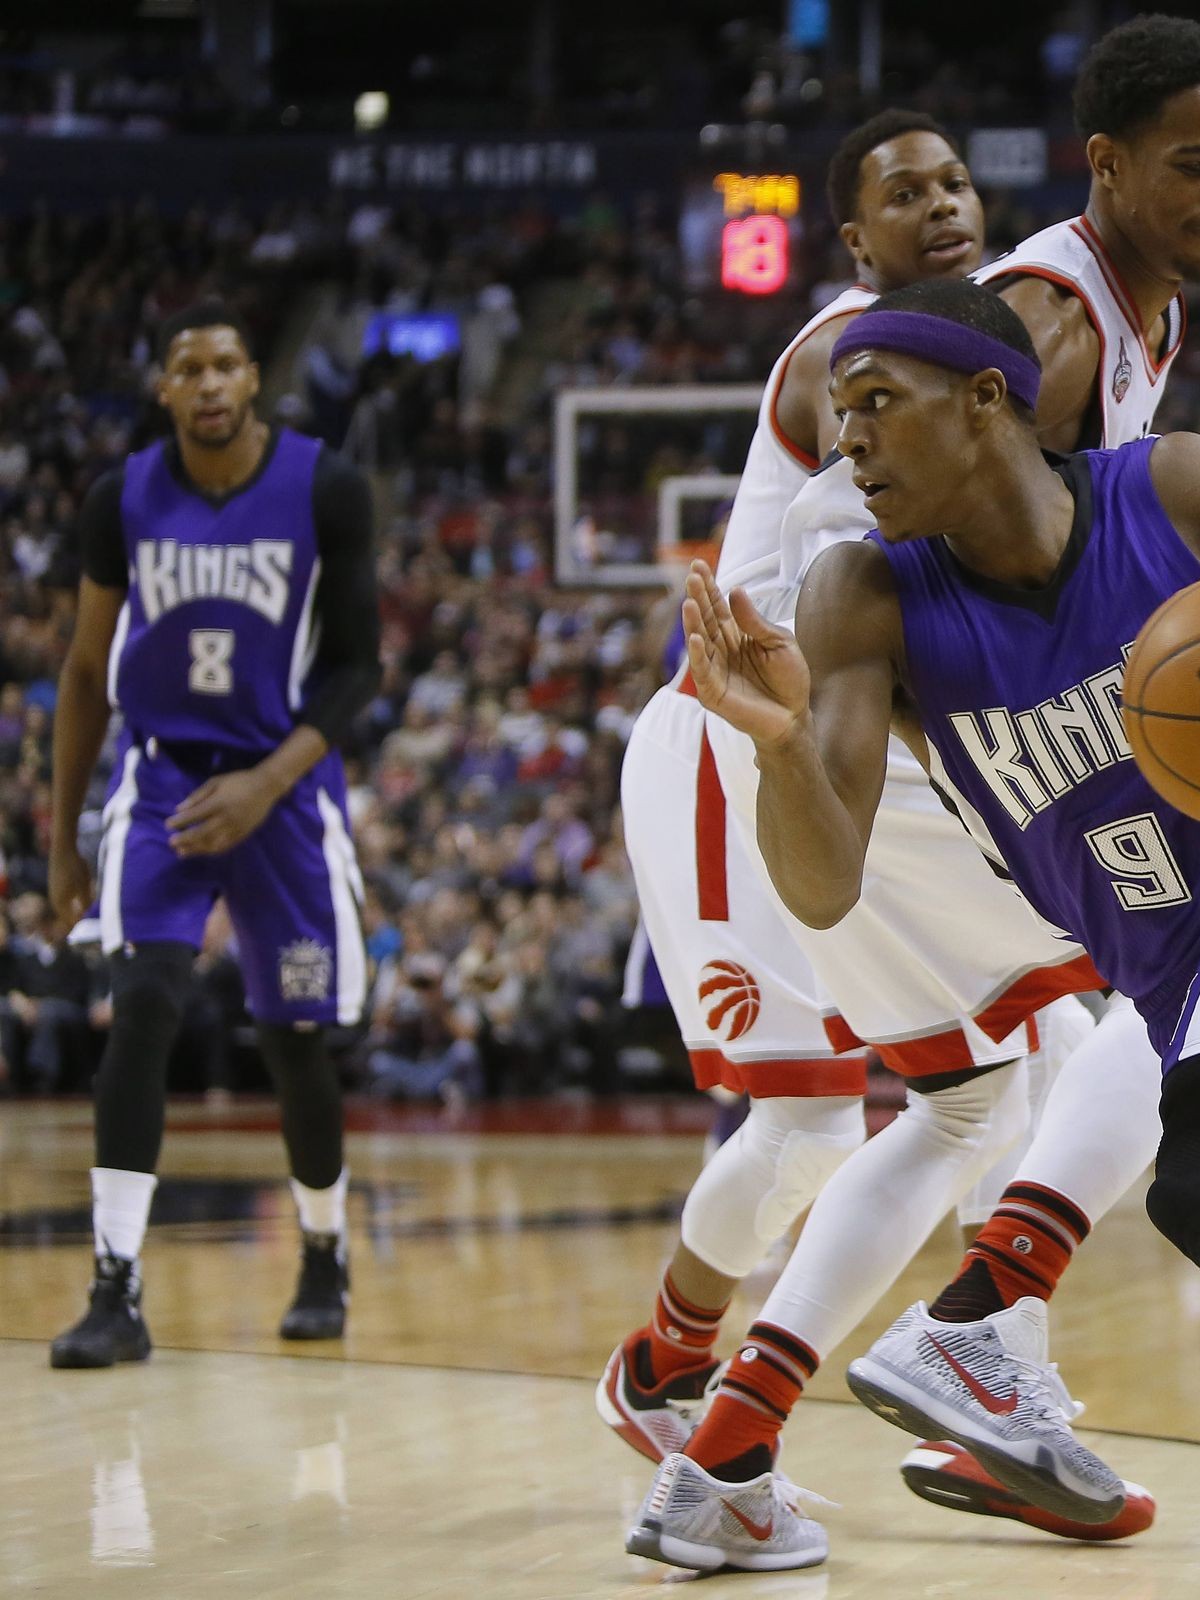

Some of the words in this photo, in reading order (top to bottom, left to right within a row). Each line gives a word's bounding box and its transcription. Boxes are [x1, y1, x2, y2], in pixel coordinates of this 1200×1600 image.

[136, 538, 293, 625] KINGS
[188, 628, 235, 694] 8
[948, 640, 1137, 831] KING
[1083, 812, 1192, 911] 9
